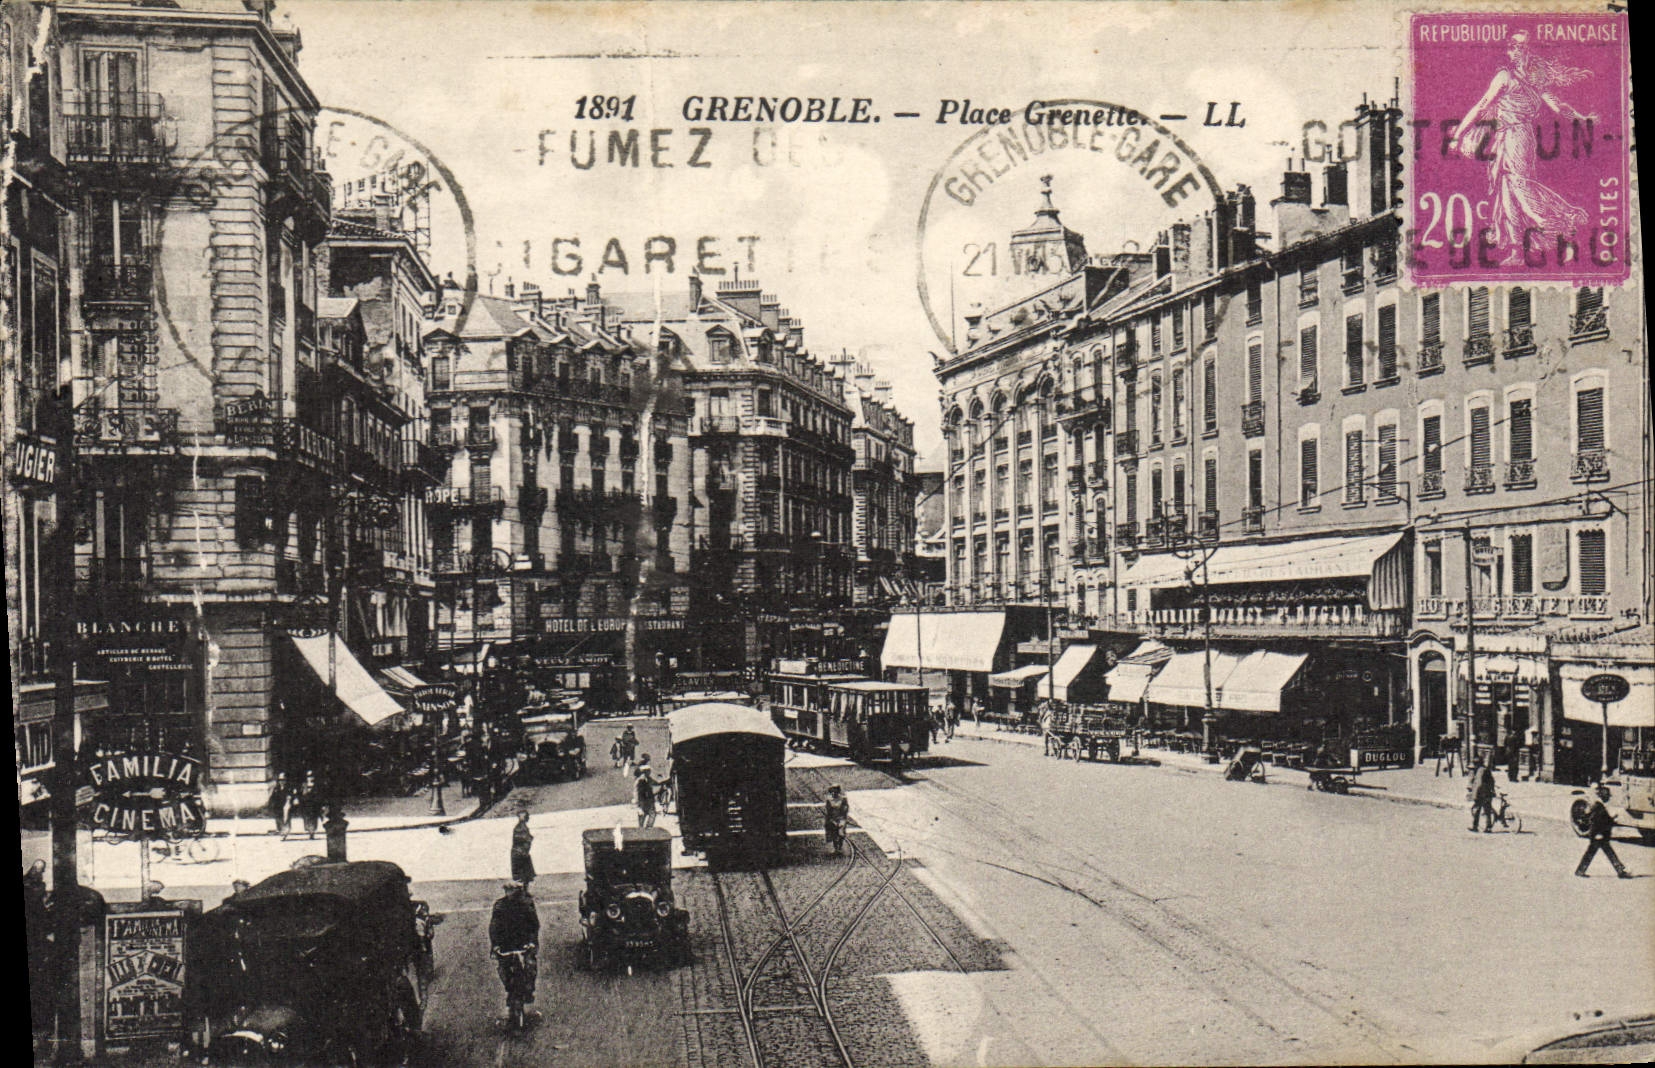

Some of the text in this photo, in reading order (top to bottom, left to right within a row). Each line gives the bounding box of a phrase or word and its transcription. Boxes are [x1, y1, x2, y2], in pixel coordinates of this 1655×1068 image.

[1536, 22, 1619, 43] FRANÇAISE
[1600, 176, 1619, 263] POSTES
[1419, 598, 1478, 615] HOTE
[545, 618, 575, 633] HOTEL
[90, 755, 192, 786] FAMILIA
[93, 802, 196, 831] CINEMA
